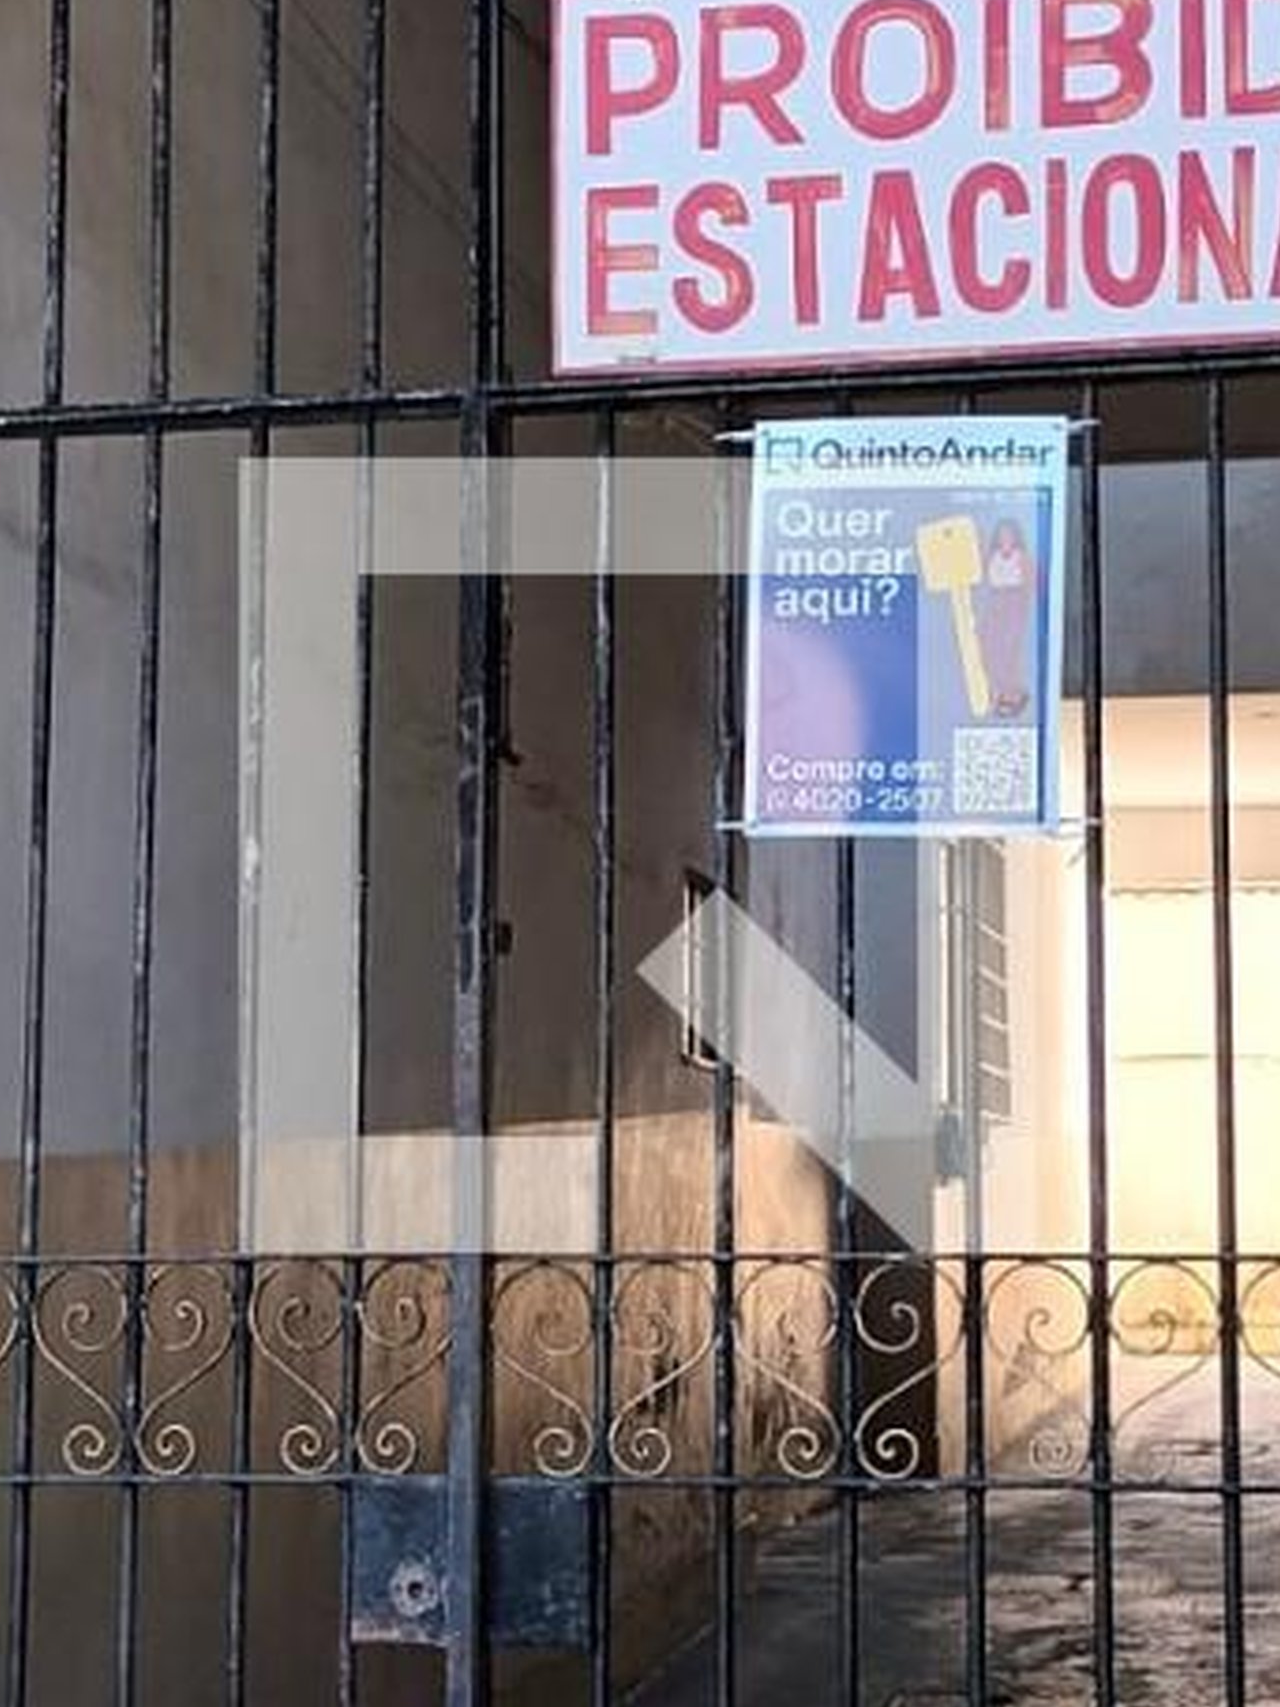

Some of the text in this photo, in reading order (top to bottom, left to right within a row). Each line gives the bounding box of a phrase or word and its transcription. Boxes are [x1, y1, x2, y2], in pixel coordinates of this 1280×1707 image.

[811, 436, 1054, 470] QuintoAndar
[778, 500, 894, 540] Quer
[776, 547, 912, 576] morar
[775, 576, 900, 625] aqui?
